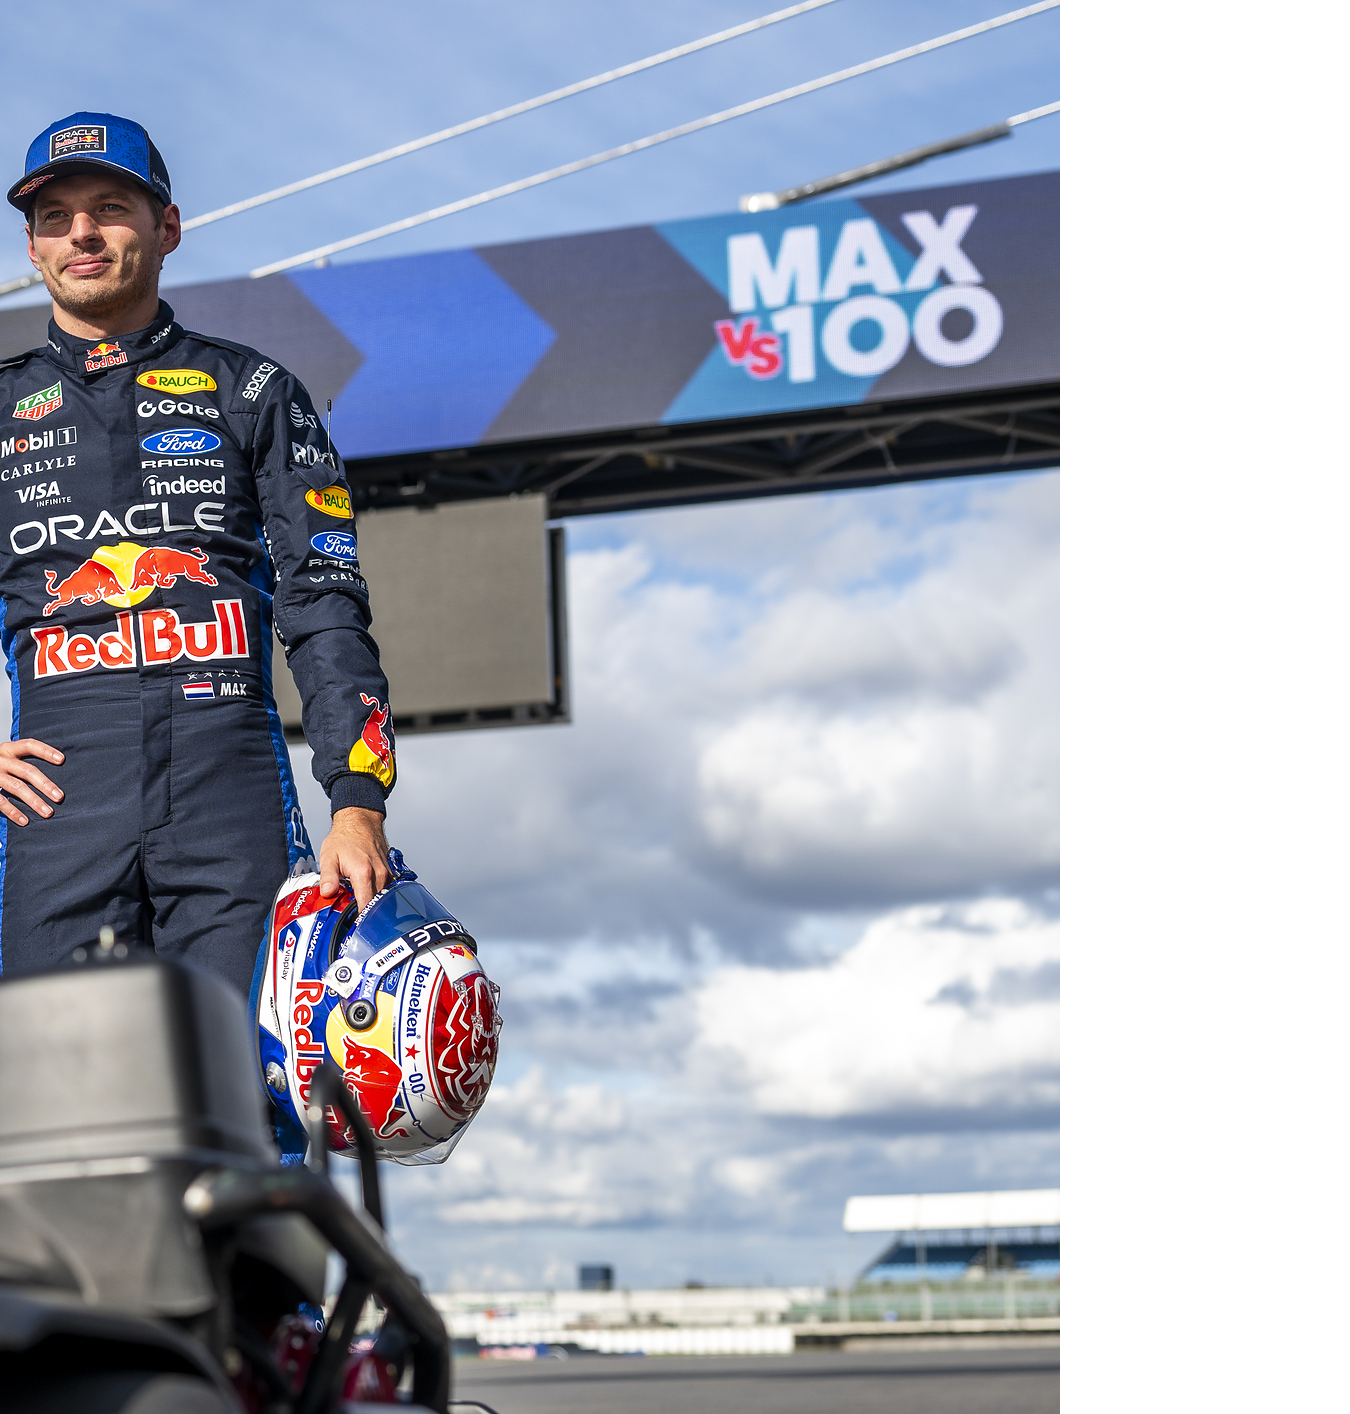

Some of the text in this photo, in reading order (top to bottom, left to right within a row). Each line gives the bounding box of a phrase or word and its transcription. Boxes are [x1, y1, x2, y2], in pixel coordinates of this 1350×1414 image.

[55, 129, 99, 141] ORACLE
[55, 143, 100, 155] RACING
[727, 203, 985, 314] MAX
[770, 282, 1004, 384] 100
[85, 351, 129, 372] Red Bull
[158, 376, 208, 387] RAUCH
[242, 362, 278, 402] sparco
[15, 398, 61, 419] HEUER
[20, 386, 60, 410] TAG
[158, 399, 220, 419] Gate
[0, 430, 54, 459] Mobil
[157, 432, 206, 451] Ford
[0, 455, 77, 482] CARLYLE
[141, 458, 225, 469] RACING
[14, 480, 61, 504] VISA
[147, 475, 226, 496] indeed
[36, 496, 72, 508] INFINITE
[323, 493, 351, 511] RAUC
[9, 501, 226, 555] ORACLE
[30, 609, 137, 680] Red
[137, 598, 250, 667] Bull
[219, 681, 248, 697] MAX
[291, 890, 311, 916] indeed
[307, 921, 324, 959] DAMAC
[409, 920, 466, 949] ACLE
[281, 949, 292, 980] viaplay
[383, 944, 405, 962] Mobil
[363, 975, 377, 998] VISA
[406, 963, 431, 1038] Heineken
[293, 980, 326, 1055] Red
